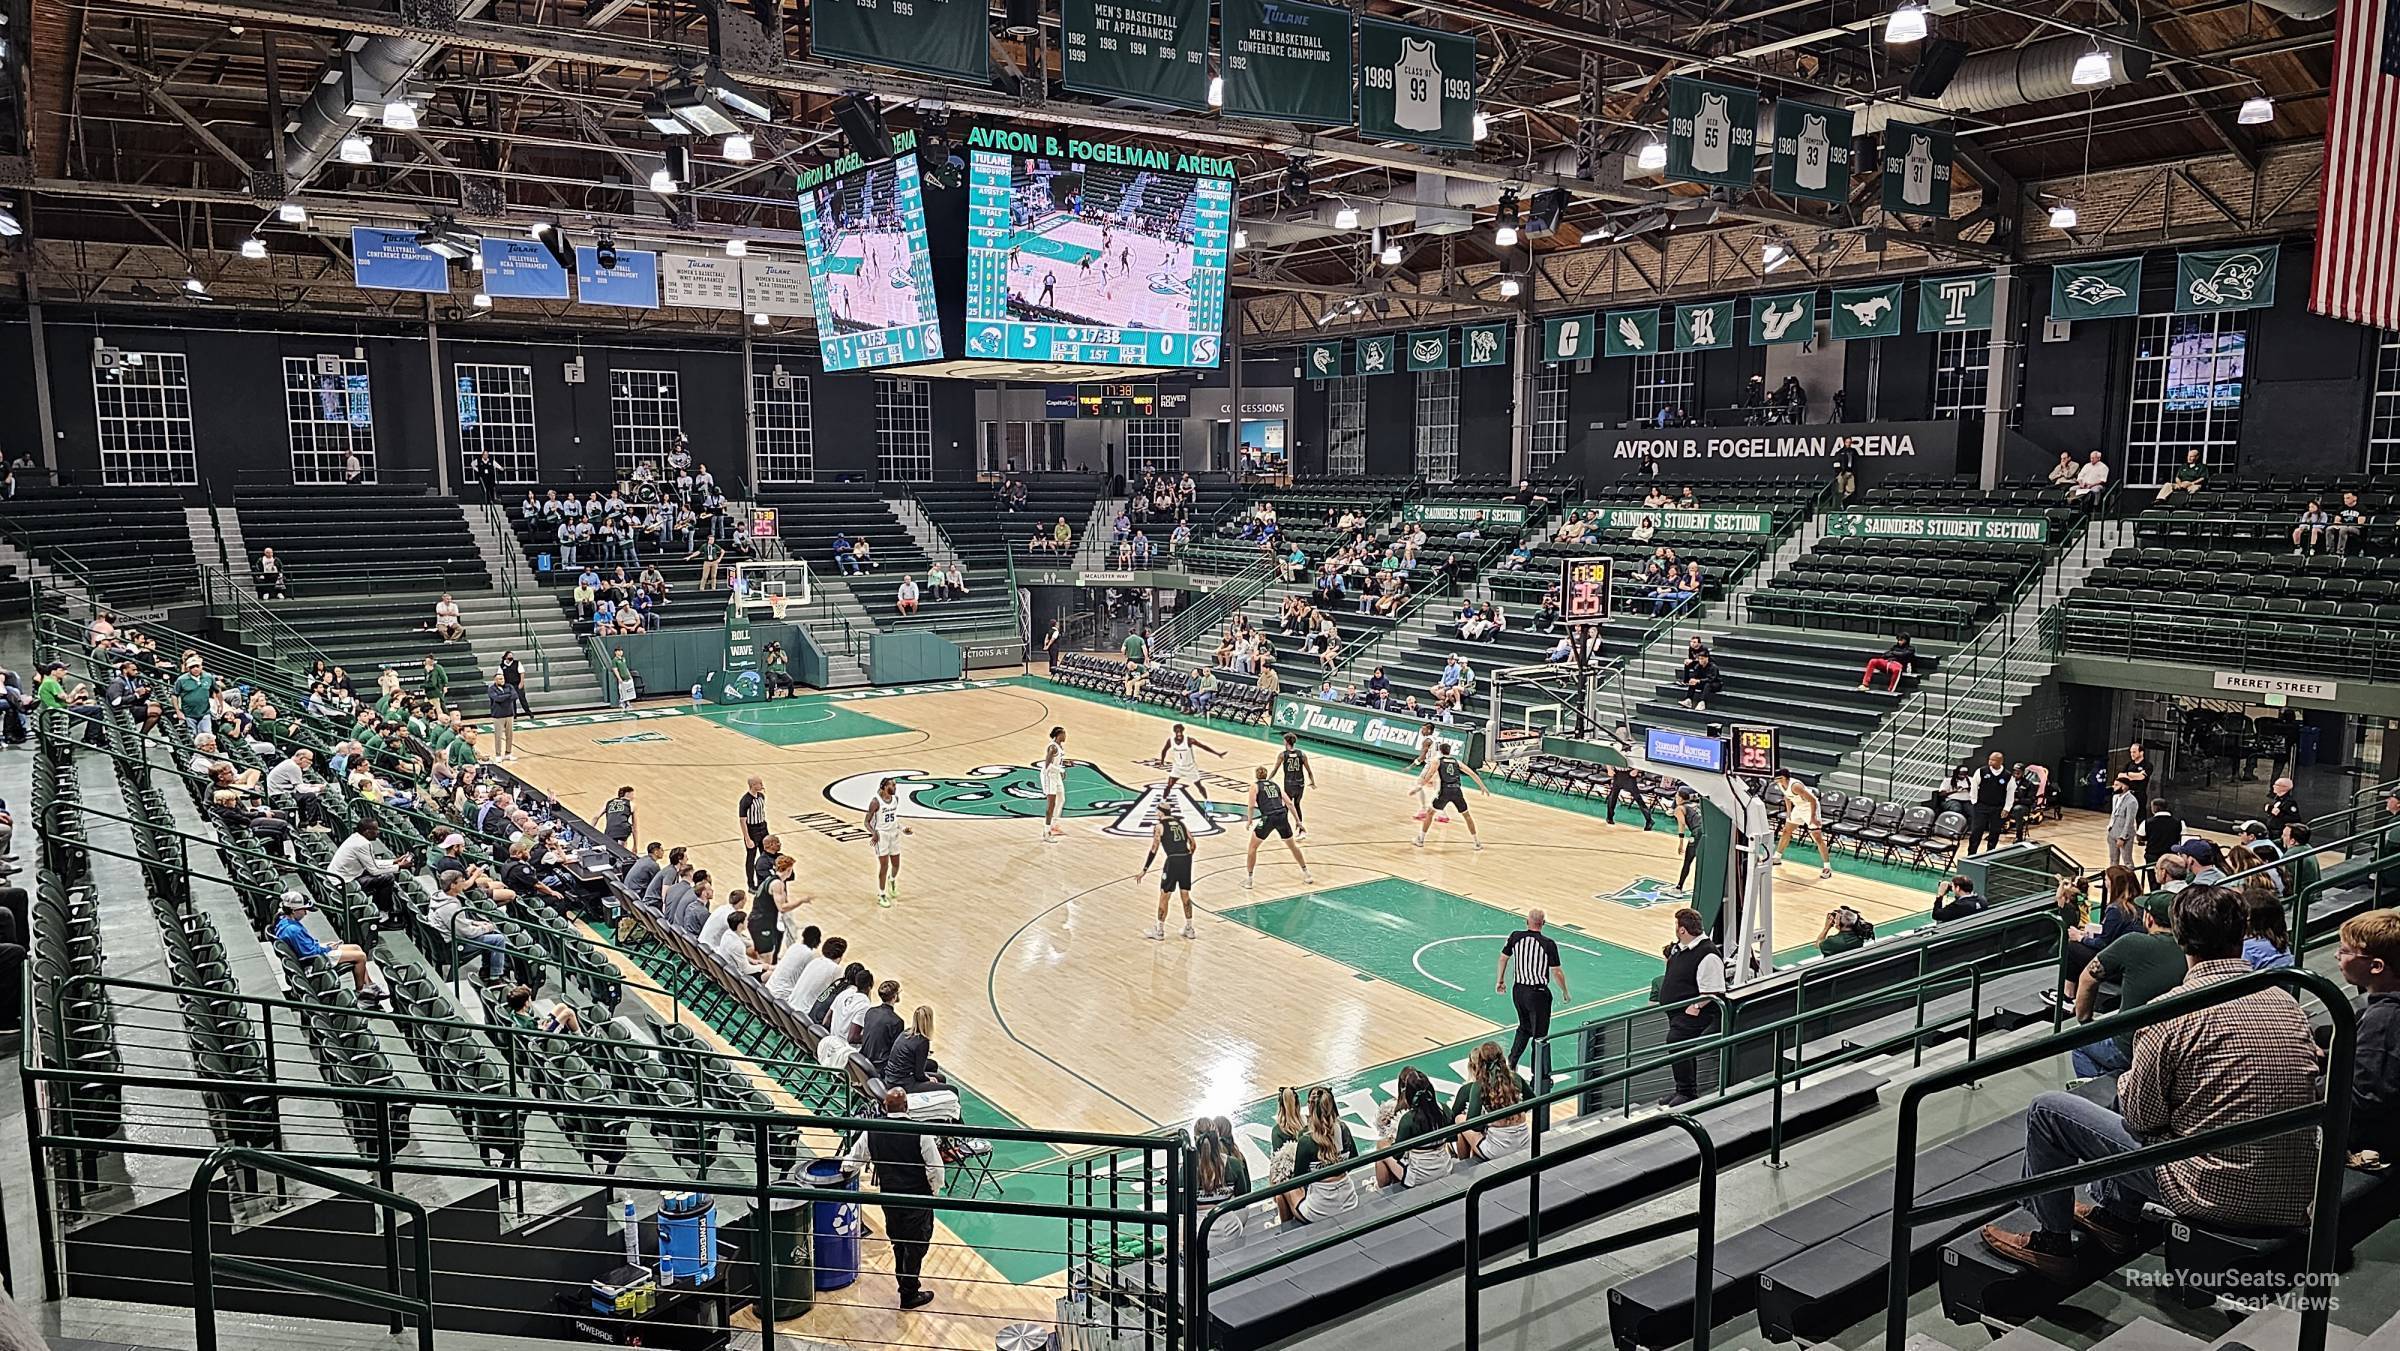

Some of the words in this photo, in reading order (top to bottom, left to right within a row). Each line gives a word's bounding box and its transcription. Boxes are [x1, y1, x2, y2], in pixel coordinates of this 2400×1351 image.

[892, 1, 913, 16] 1995
[1095, 3, 1122, 19] MEN'S
[1125, 8, 1178, 28] BASKETBALL
[1262, 4, 1310, 26] TULANE
[1096, 18, 1110, 31] NIT
[1114, 21, 1173, 41] APPEARANCES
[1249, 28, 1273, 42] MEN'S
[1276, 32, 1323, 48] BASKETBALL
[1068, 32, 1086, 46] 1982
[1100, 37, 1117, 51] 1983
[1130, 42, 1147, 56] 1994
[1160, 46, 1176, 60] 1996
[1187, 51, 1203, 64] 1997
[1068, 49, 1086, 62] 1999
[1238, 40, 1285, 57] CONFERENCE
[1287, 47, 1330, 62] CHAMPIONS
[1229, 55, 1247, 70] 1992
[1364, 65, 1393, 90] 1989
[1404, 65, 1422, 76] CLASS
[1425, 70, 1432, 78] OF
[1410, 77, 1427, 103] 93
[1444, 78, 1471, 100] 1993
[1672, 117, 1693, 138] 1989
[1704, 127, 1718, 148] 55
[1731, 127, 1752, 147] 1993
[967, 126, 1037, 154] AVRON
[1046, 137, 1064, 158] B.
[1069, 139, 1170, 171] FOGELMAN
[1176, 154, 1235, 179] ARENA
[1778, 137, 1796, 156] 1980
[974, 153, 1010, 165] TULANE
[1806, 146, 1819, 166] 33
[1830, 146, 1847, 165] 1983
[796, 166, 823, 192] AVRON
[825, 163, 834, 180] B.
[834, 152, 865, 177] FOGEL
[1887, 156, 1903, 175] 1967
[1934, 164, 1949, 181] 1969
[988, 176, 995, 185] 3
[1913, 164, 1923, 184] 31
[988, 197, 994, 206] 1
[1209, 201, 1216, 210] 3
[987, 218, 994, 227] 0
[1208, 220, 1215, 229] 0
[382, 245, 416, 254] VOLLEYBALL
[987, 238, 994, 247] 0
[1207, 239, 1214, 248] 0
[366, 251, 400, 260] CONFERENCE
[401, 253, 433, 261] CHAMPIONS
[1205, 259, 1212, 267] 0
[515, 262, 548, 270] TOURNAMENT
[687, 259, 715, 269] TULANE
[698, 270, 726, 278] BASKETBALL
[2052, 323, 2061, 339] L
[843, 339, 851, 359] 5
[866, 332, 888, 347] 17:38
[906, 329, 915, 350] 0
[1023, 326, 1037, 348] 5
[1080, 329, 1122, 344] 17:38
[1160, 335, 1173, 355] 0
[1803, 341, 1812, 354] K
[102, 353, 113, 365] D
[1089, 349, 1109, 361] 1ST
[326, 362, 334, 373] E
[571, 370, 579, 381] F
[776, 375, 787, 387] G
[1105, 385, 1132, 396] 17:38
[1092, 404, 1099, 415] 5
[1116, 405, 1121, 414] 1
[1145, 404, 1153, 416] 0
[1220, 404, 1285, 413] CCESSIONS
[1613, 439, 1680, 459] AVRON
[1682, 438, 1702, 459] B.
[1707, 436, 1826, 459] FOGELMAN
[1829, 434, 1915, 457] ARENA
[754, 511, 774, 521] 17:38
[1424, 507, 1458, 521] SAUNDERS
[1490, 510, 1522, 523] SECTION
[1610, 510, 1662, 528] SAUNDRS
[1664, 513, 1712, 530] STUDENT
[1715, 514, 1761, 532] SECTION
[754, 520, 773, 536] 25
[1865, 518, 1924, 535] SAUNDERS
[1927, 519, 1983, 537] STUDENT
[1985, 521, 2041, 540] SECTION
[1572, 564, 1604, 582] 17:38
[731, 630, 751, 641] ROLL
[730, 645, 753, 657] WAVE
[996, 648, 1009, 656] A-E
[2227, 676, 2272, 689] FRERET
[2276, 681, 2323, 695] STREET
[1300, 703, 1358, 734] TULANE
[1363, 718, 1418, 745] GREEN
[1742, 732, 1771, 749] 17:38
[1287, 757, 1300, 772] 24
[1743, 747, 1767, 768] 25
[1446, 763, 1455, 776] 4
[608, 801, 625, 813] 25
[884, 813, 895, 823] 25
[2174, 1225, 2188, 1241] 12
[699, 1217, 708, 1266] POWERADE
[1948, 1251, 1956, 1264] 11
[1762, 1276, 1771, 1289] 10
[576, 1320, 614, 1343] POWERADE
